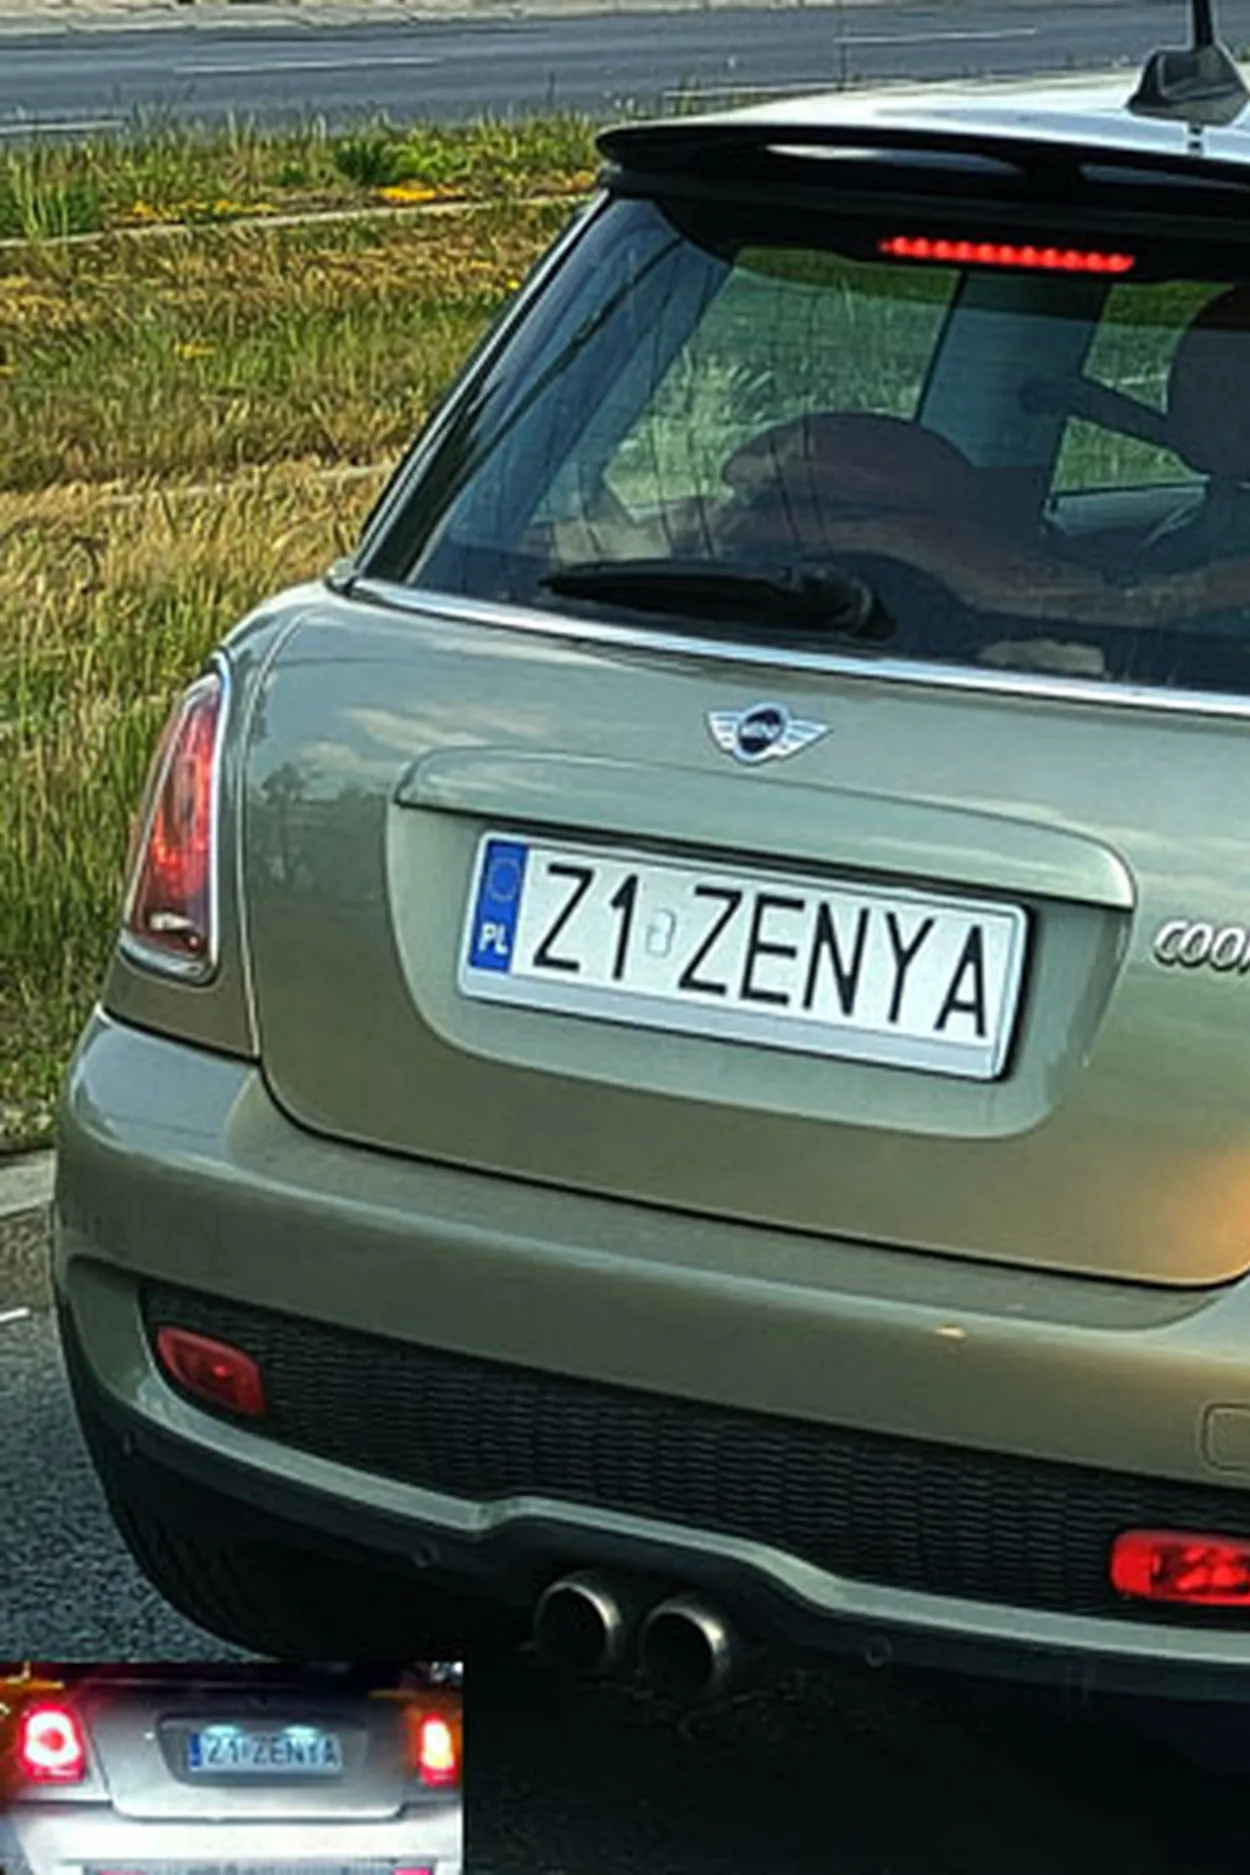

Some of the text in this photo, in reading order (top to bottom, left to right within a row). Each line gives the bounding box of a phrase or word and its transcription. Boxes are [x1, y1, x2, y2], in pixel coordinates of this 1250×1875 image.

[477, 921, 510, 955] PL
[532, 862, 988, 1039] Z1 ZENYA
